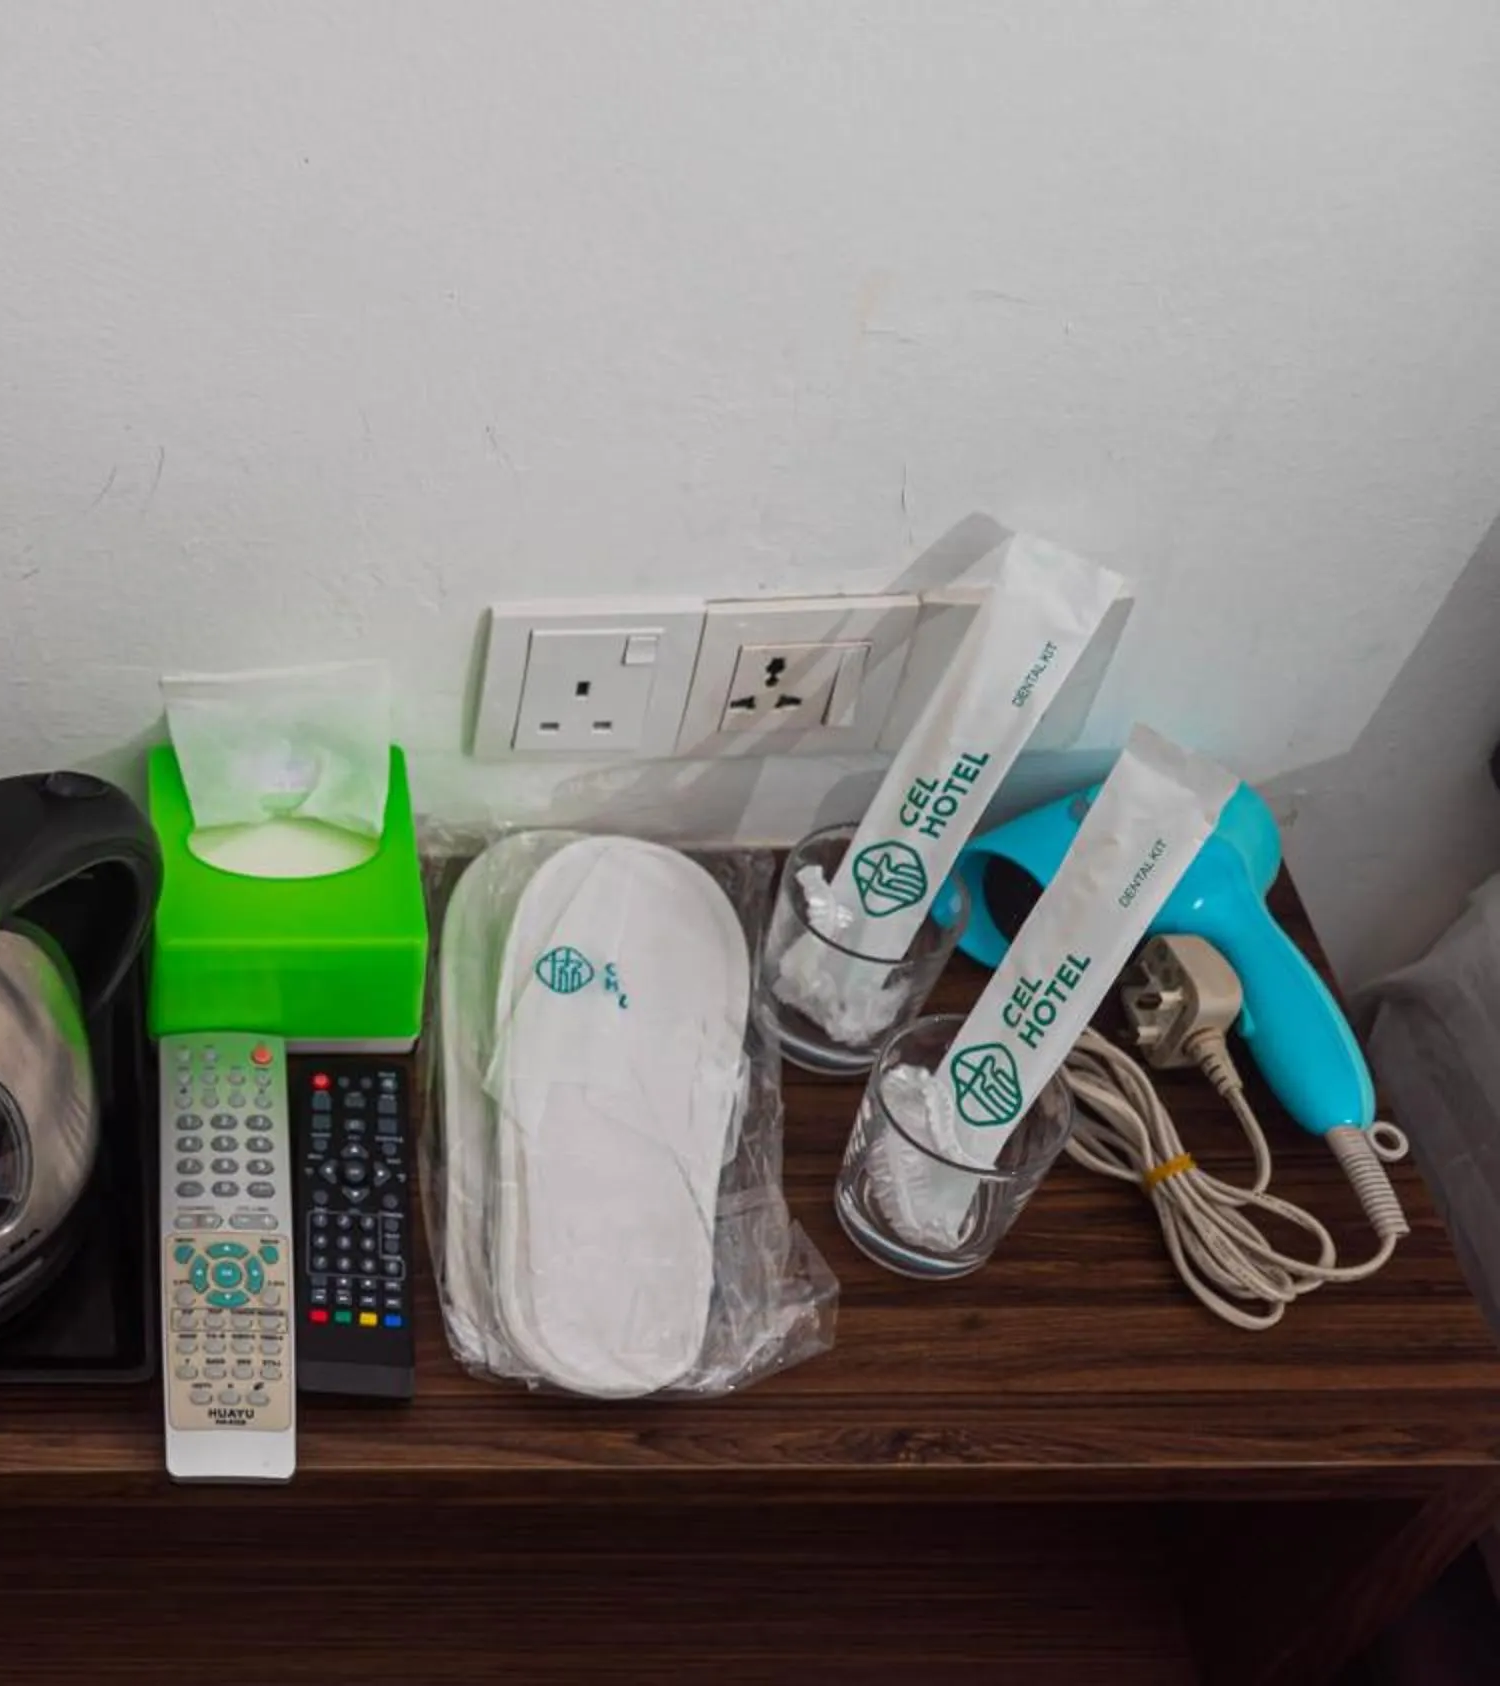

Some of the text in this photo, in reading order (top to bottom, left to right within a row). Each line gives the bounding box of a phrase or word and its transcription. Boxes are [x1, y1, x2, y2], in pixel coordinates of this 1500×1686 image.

[1011, 640, 1057, 708] DENTAL KIT
[899, 777, 939, 828] CEL
[918, 752, 990, 839] HOTEL
[1117, 838, 1167, 909] DENTAL KIT
[1002, 976, 1042, 1028] CEL
[1018, 953, 1091, 1049] HOTEL
